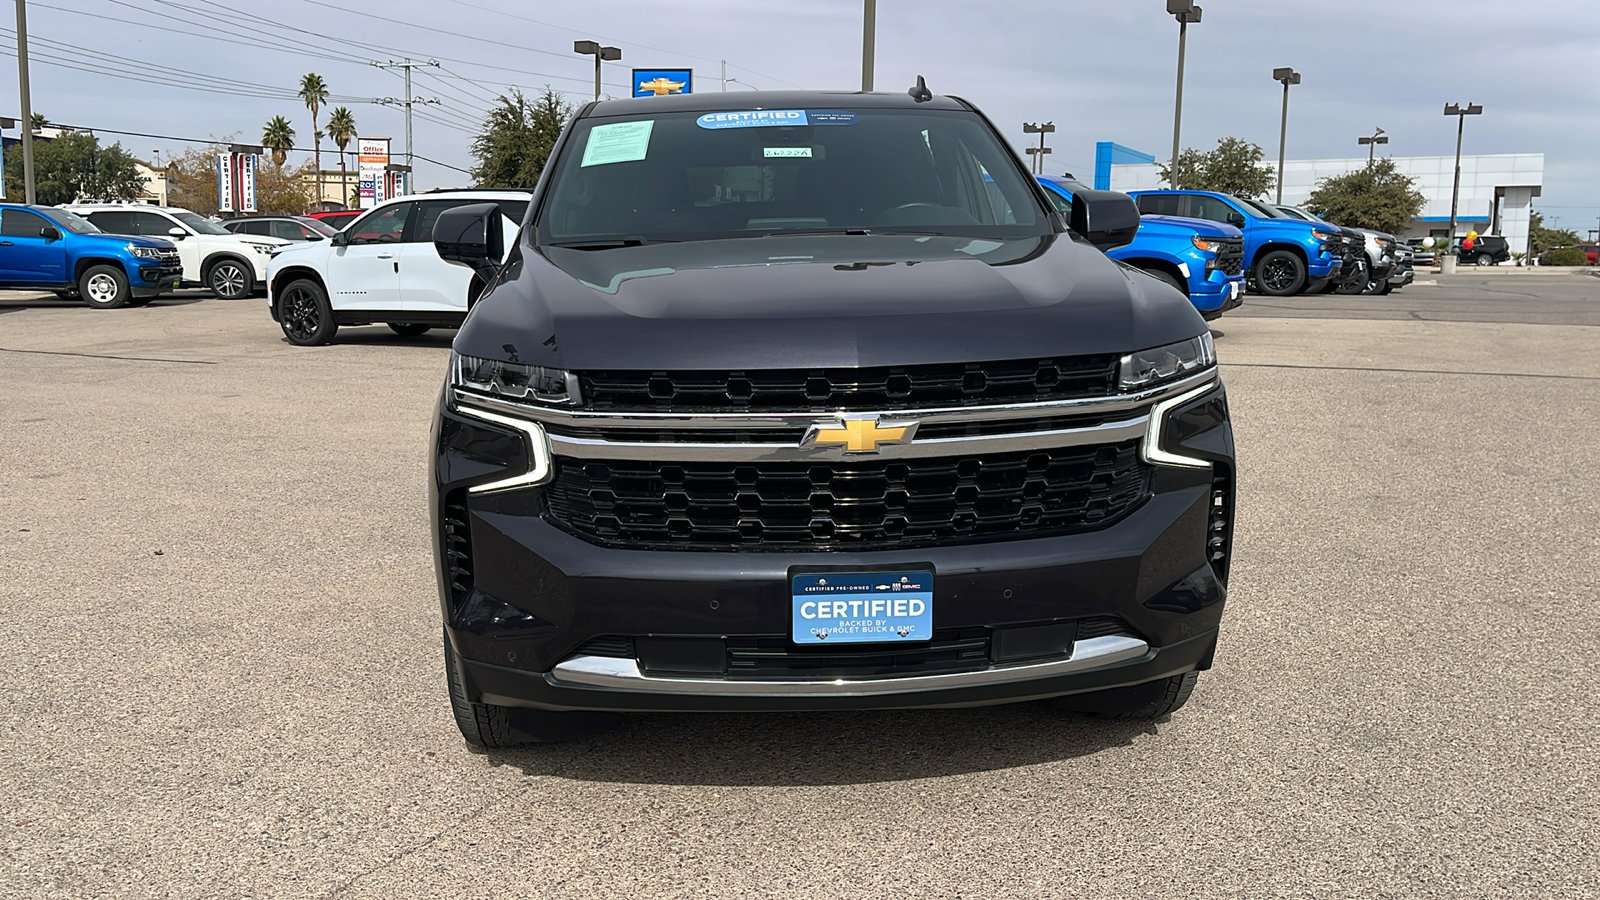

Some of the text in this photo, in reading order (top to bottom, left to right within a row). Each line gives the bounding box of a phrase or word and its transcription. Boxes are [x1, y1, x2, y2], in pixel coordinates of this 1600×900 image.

[702, 112, 800, 122] CERTIFIED
[222, 156, 230, 208] CERTIFIED
[800, 599, 926, 619] CERTIFIED
[810, 627, 859, 635] CHEVROLET
